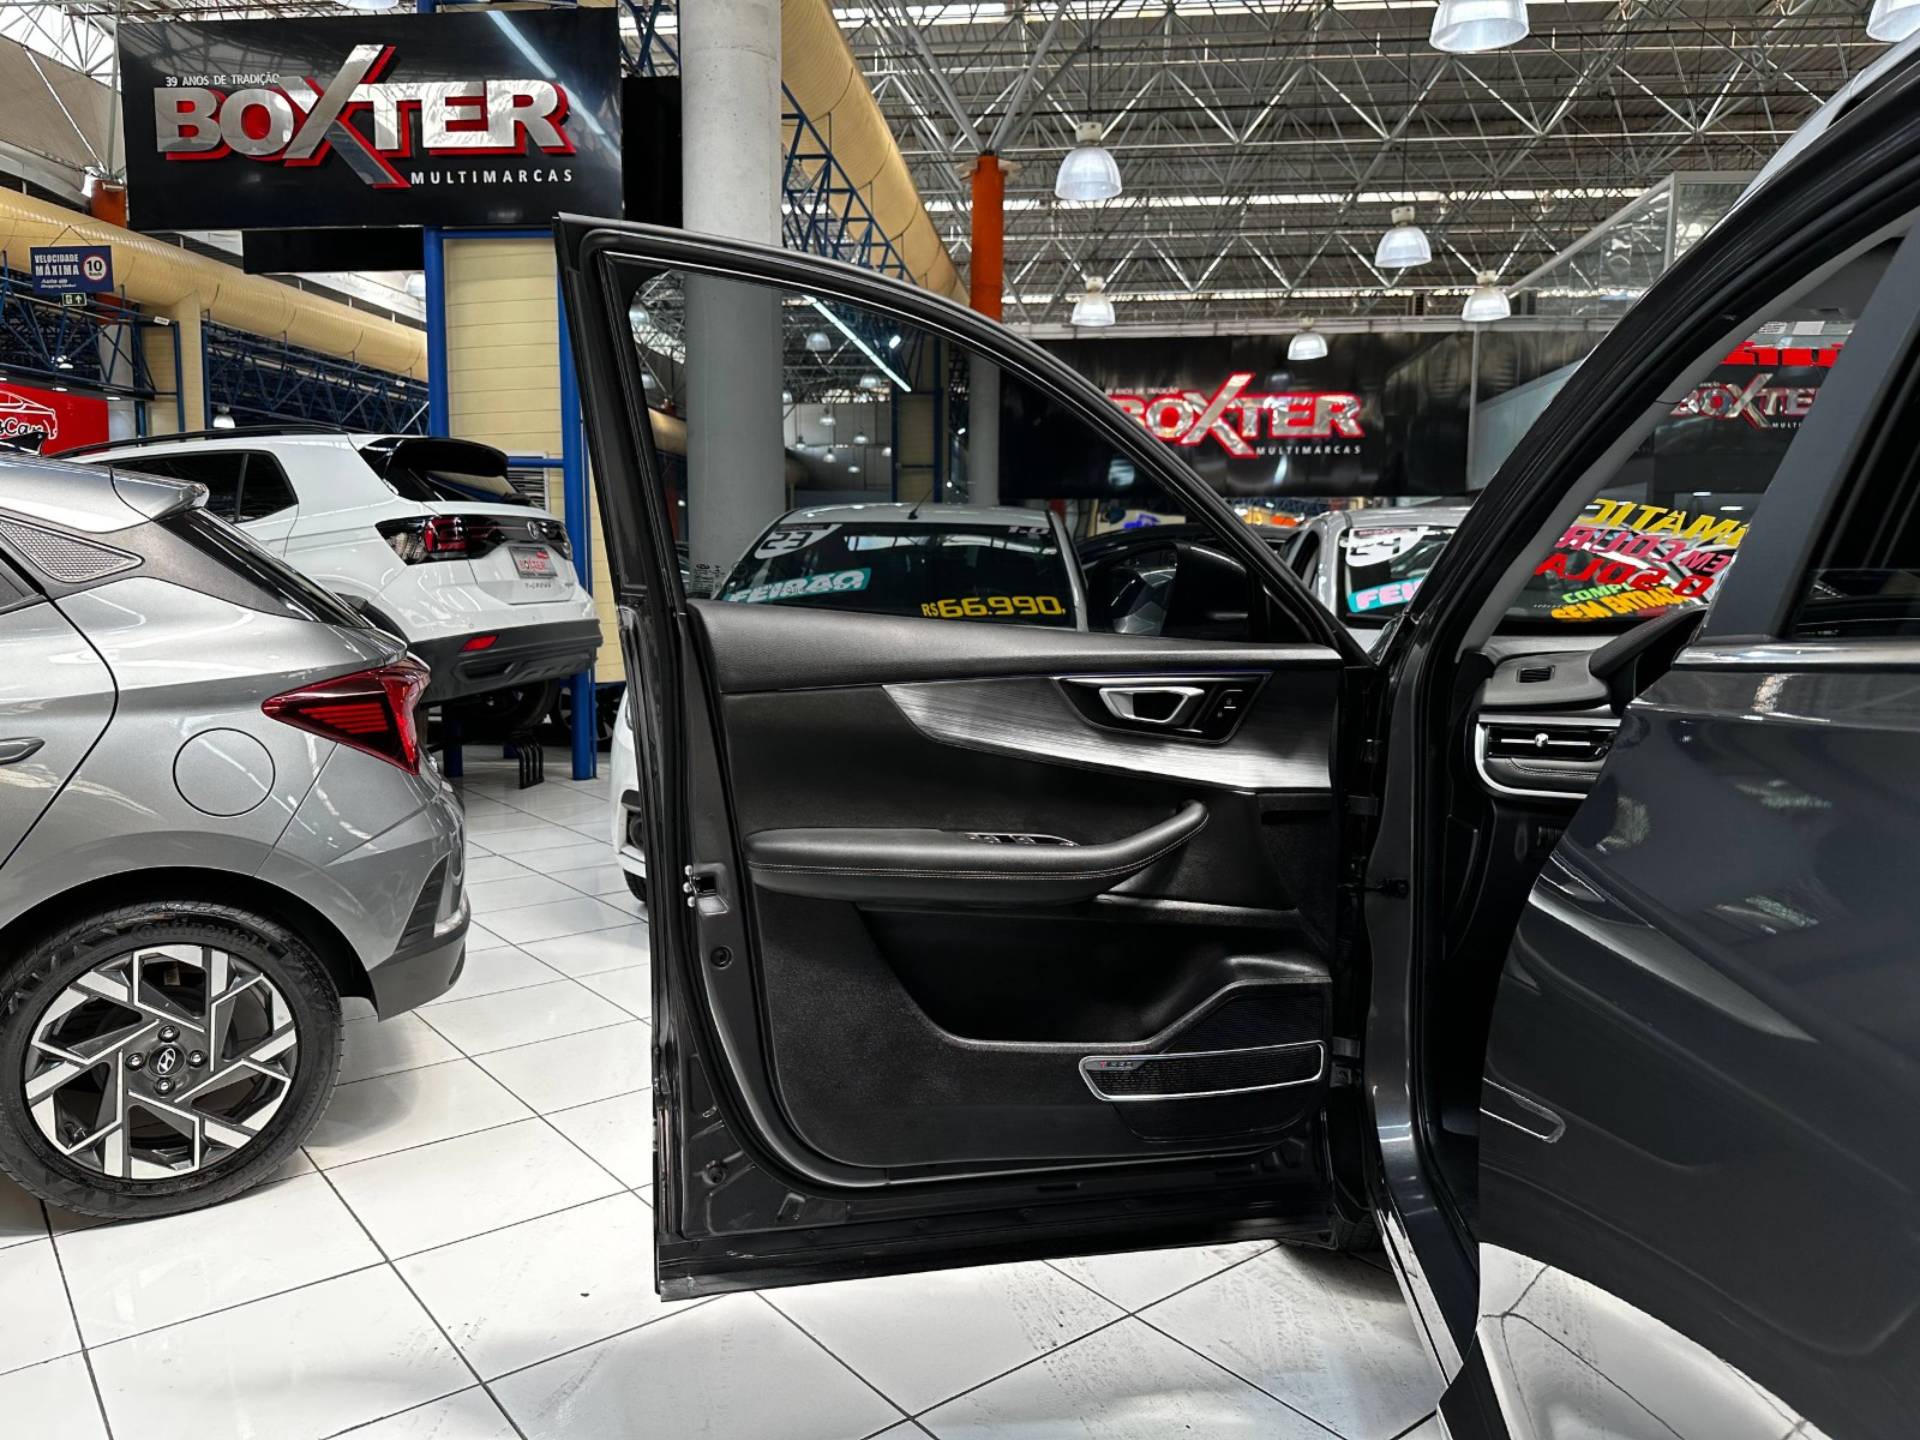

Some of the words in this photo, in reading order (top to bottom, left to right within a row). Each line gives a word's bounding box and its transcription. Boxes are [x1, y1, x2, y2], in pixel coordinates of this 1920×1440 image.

[165, 76, 178, 87] 39
[182, 75, 209, 87] ANOS
[214, 74, 226, 85] DE
[231, 72, 281, 86] TRADIÇÃO
[154, 44, 574, 188] BOXTER
[411, 169, 574, 186] MULTIMARCAS
[34, 253, 79, 264] VELOCIDADE
[35, 263, 80, 276] MÁXIMA
[86, 260, 103, 272] 10
[1256, 446, 1361, 455] MULTIMARCAS
[761, 531, 813, 550] 23
